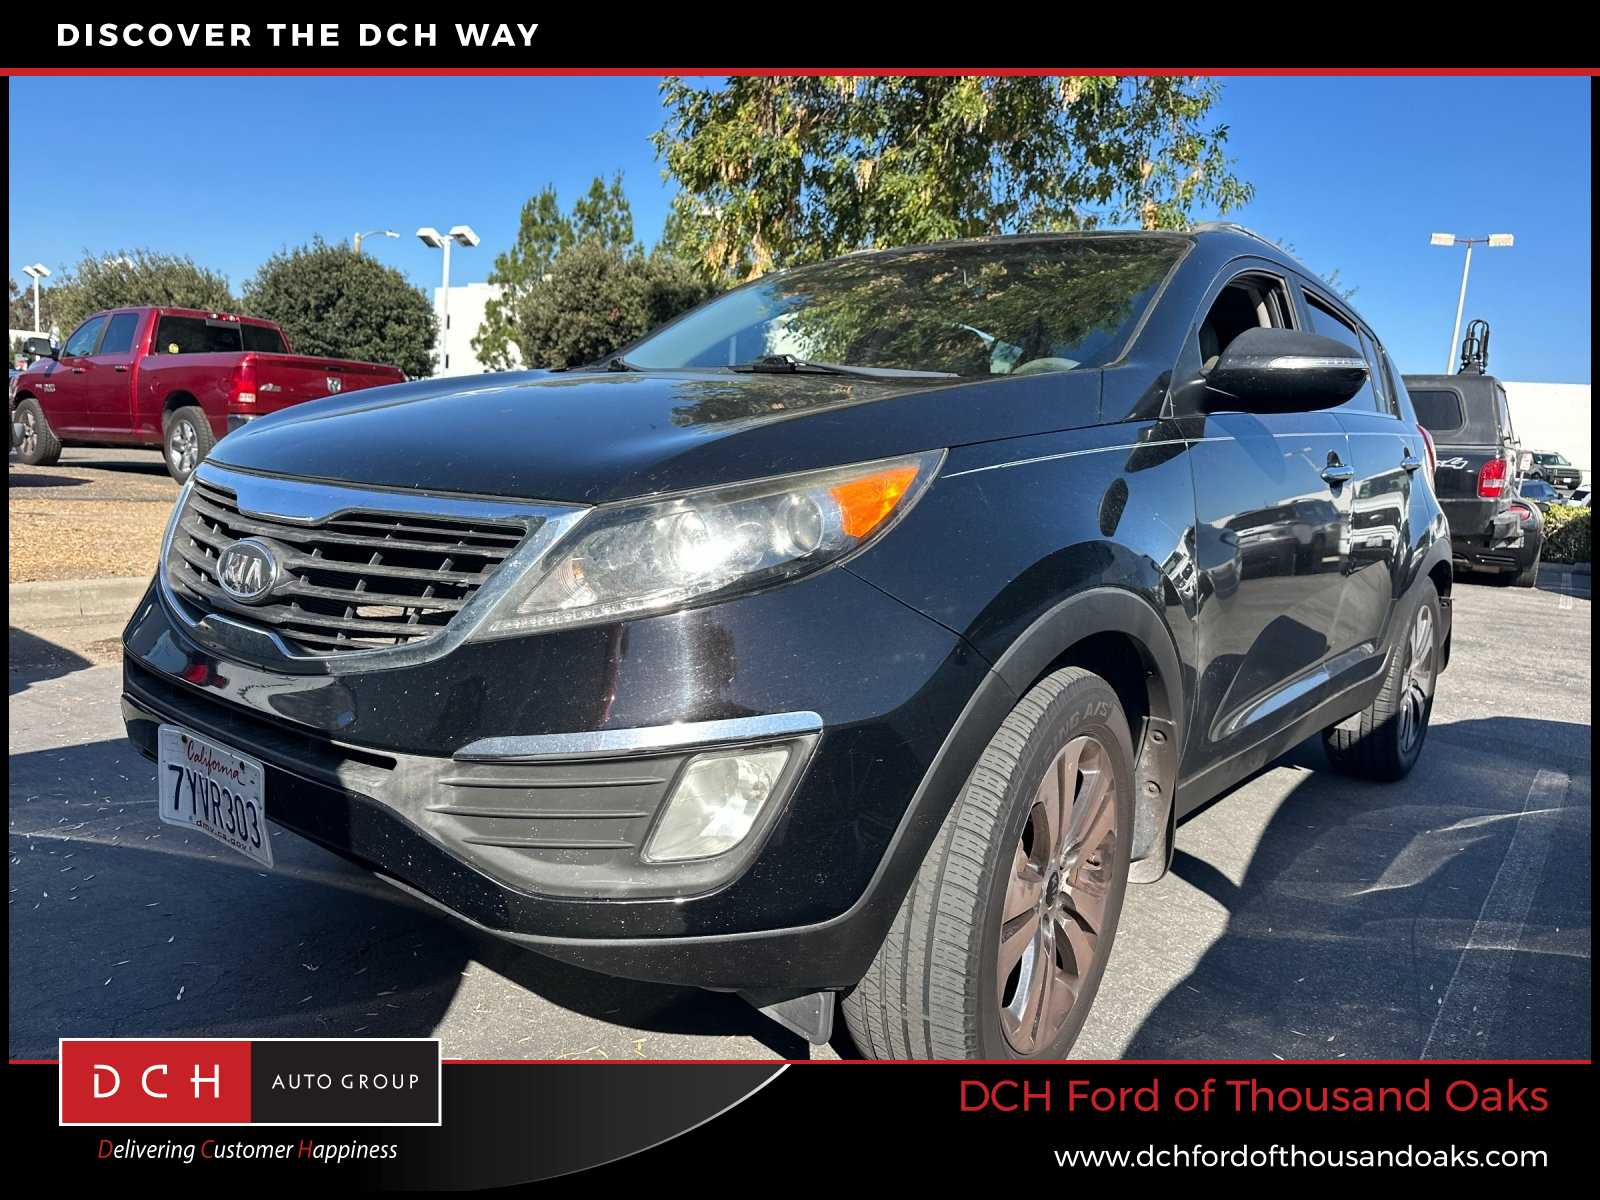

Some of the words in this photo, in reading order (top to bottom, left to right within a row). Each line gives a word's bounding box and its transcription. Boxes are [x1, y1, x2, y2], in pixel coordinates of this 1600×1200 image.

[224, 551, 262, 592] KIA
[187, 739, 246, 786] California
[167, 763, 262, 849] 7YVR303
